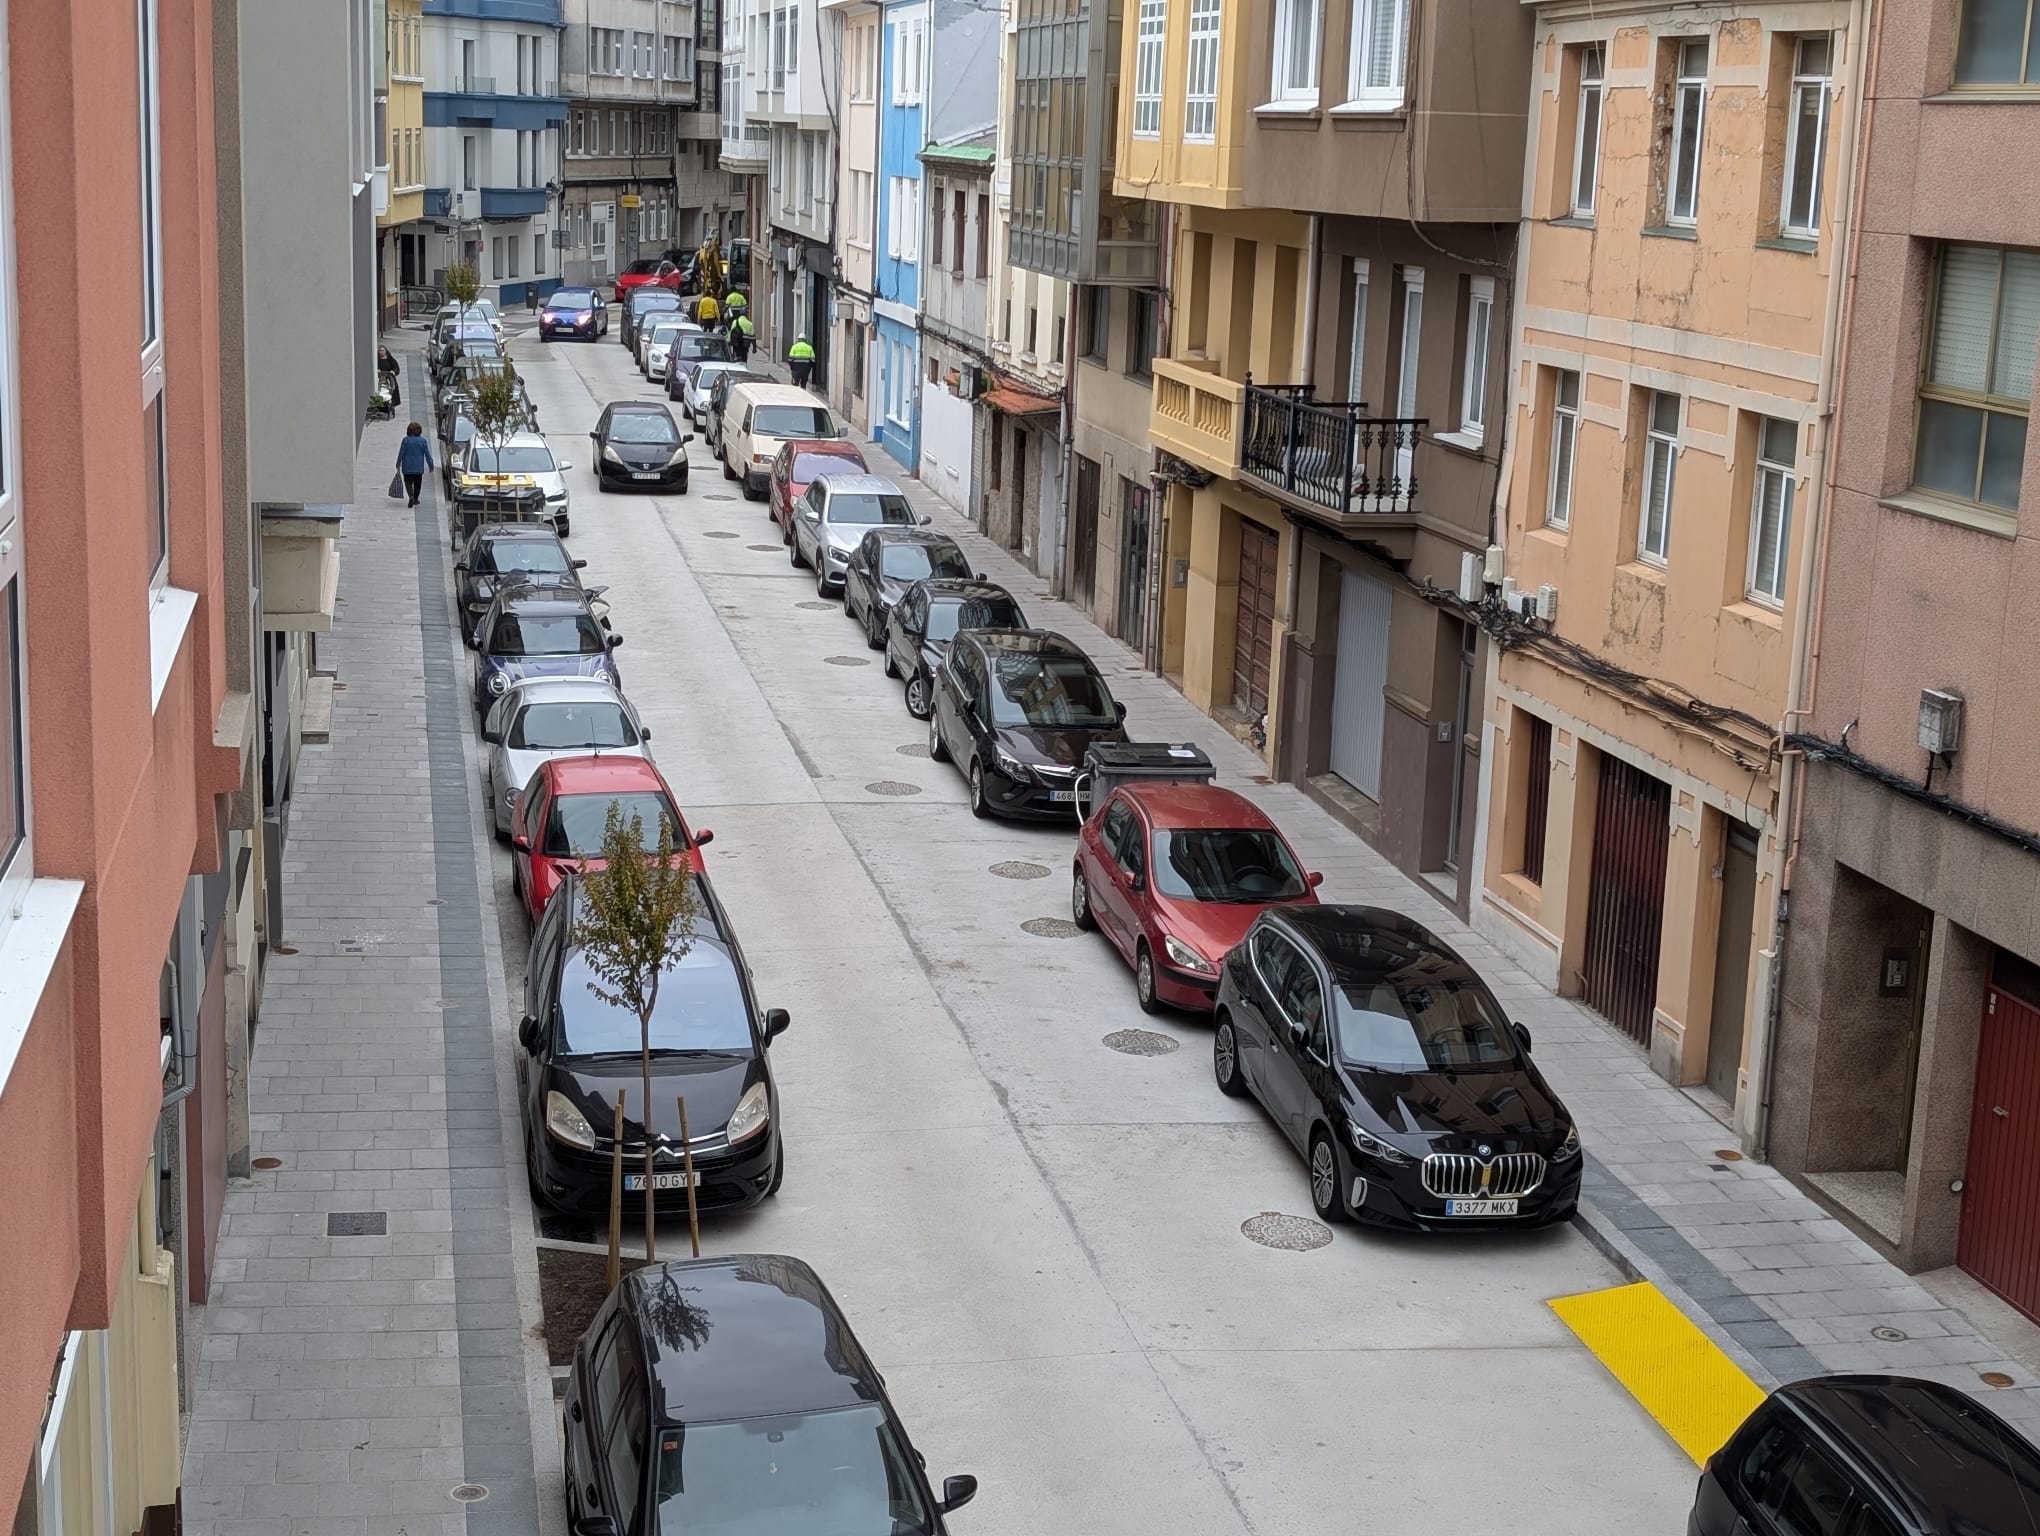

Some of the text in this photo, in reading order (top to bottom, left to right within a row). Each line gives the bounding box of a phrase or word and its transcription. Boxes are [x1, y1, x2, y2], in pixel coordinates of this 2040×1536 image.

[671, 1173, 696, 1187] GY
[1455, 1201, 1515, 1214] 3377 MKX
